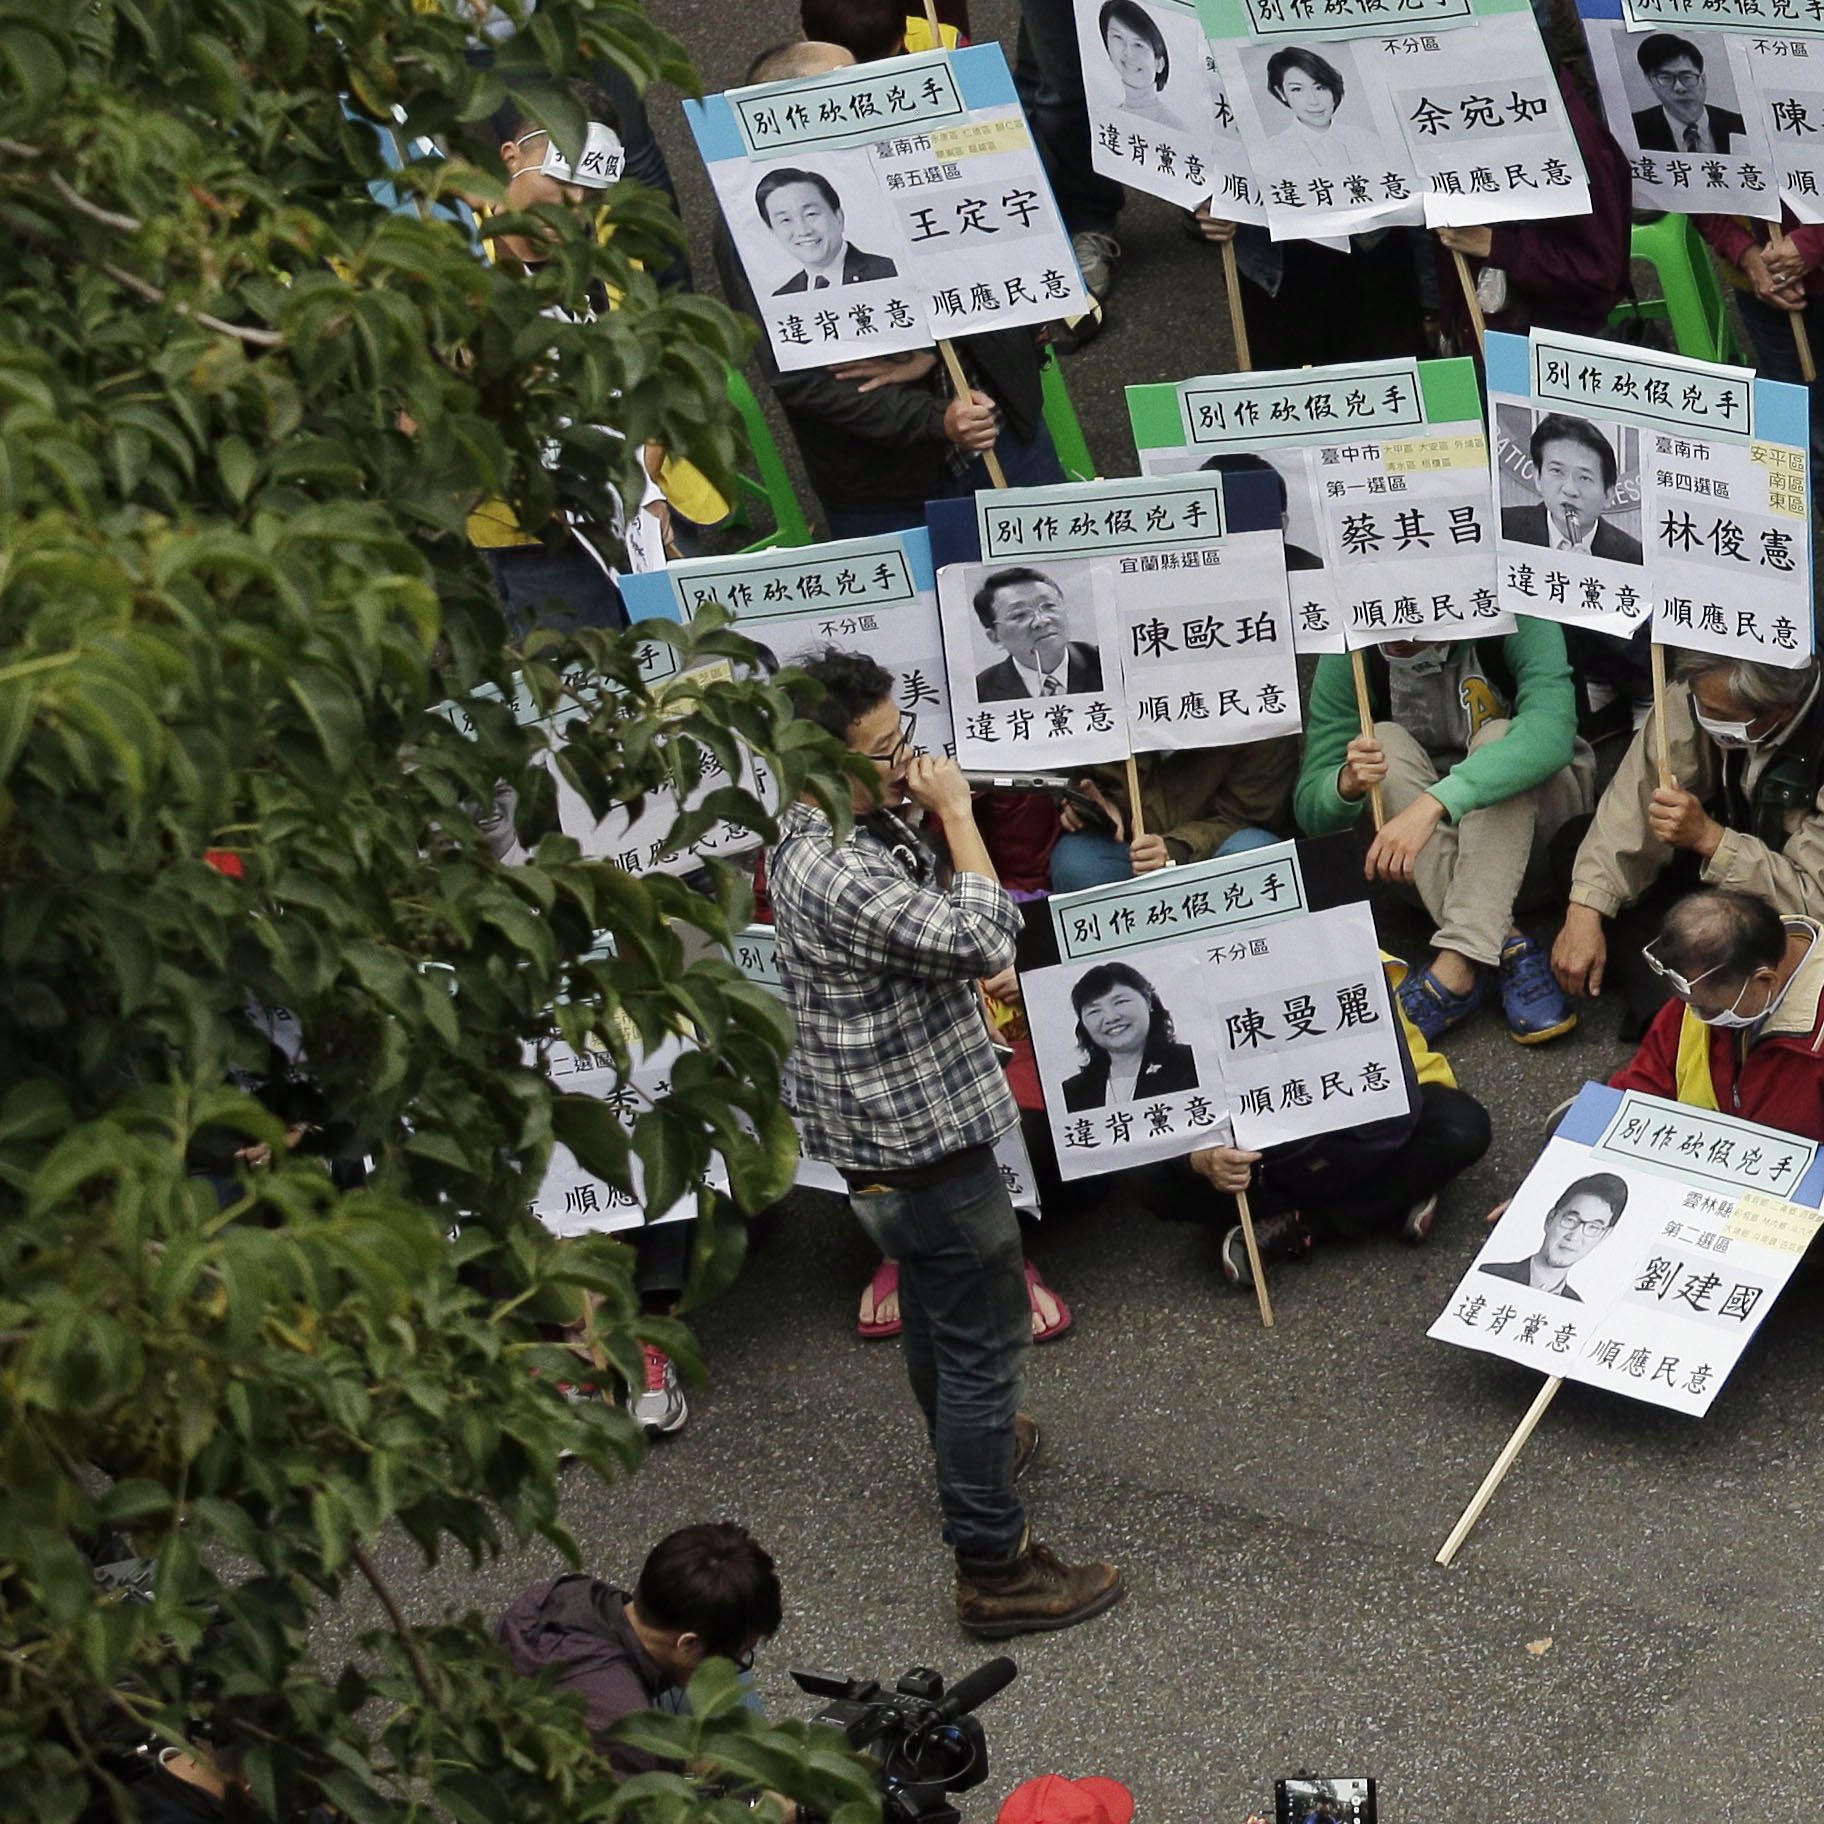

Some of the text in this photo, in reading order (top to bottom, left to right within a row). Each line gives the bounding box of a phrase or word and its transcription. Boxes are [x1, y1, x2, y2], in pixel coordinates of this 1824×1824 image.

[1382, 36, 1441, 55] 不分區
[1753, 39, 1808, 58] 不分區
[754, 79, 945, 136] 別作砍假兇手
[1410, 93, 1548, 134] 余宛如
[885, 162, 963, 191] 第五選區
[1098, 124, 1206, 186] 違背黨意
[910, 189, 1041, 244] 王定宇
[1545, 361, 1736, 420] 別作砍假兇手
[1320, 444, 1380, 464] 臺中市
[1655, 470, 1729, 499] 第四選區
[1341, 504, 1482, 556] 蔡其昌
[1660, 509, 1796, 572] 林俊憲
[1118, 548, 1222, 574] 宜蘭縣選區
[1129, 608, 1279, 657] 陳歐珀
[1072, 874, 1285, 941] 別作砍假兇手
[1225, 983, 1381, 1051] 陳曼麗
[1636, 1256, 1763, 1323] 劉建國
[1453, 1293, 1572, 1355] 違背黨意
